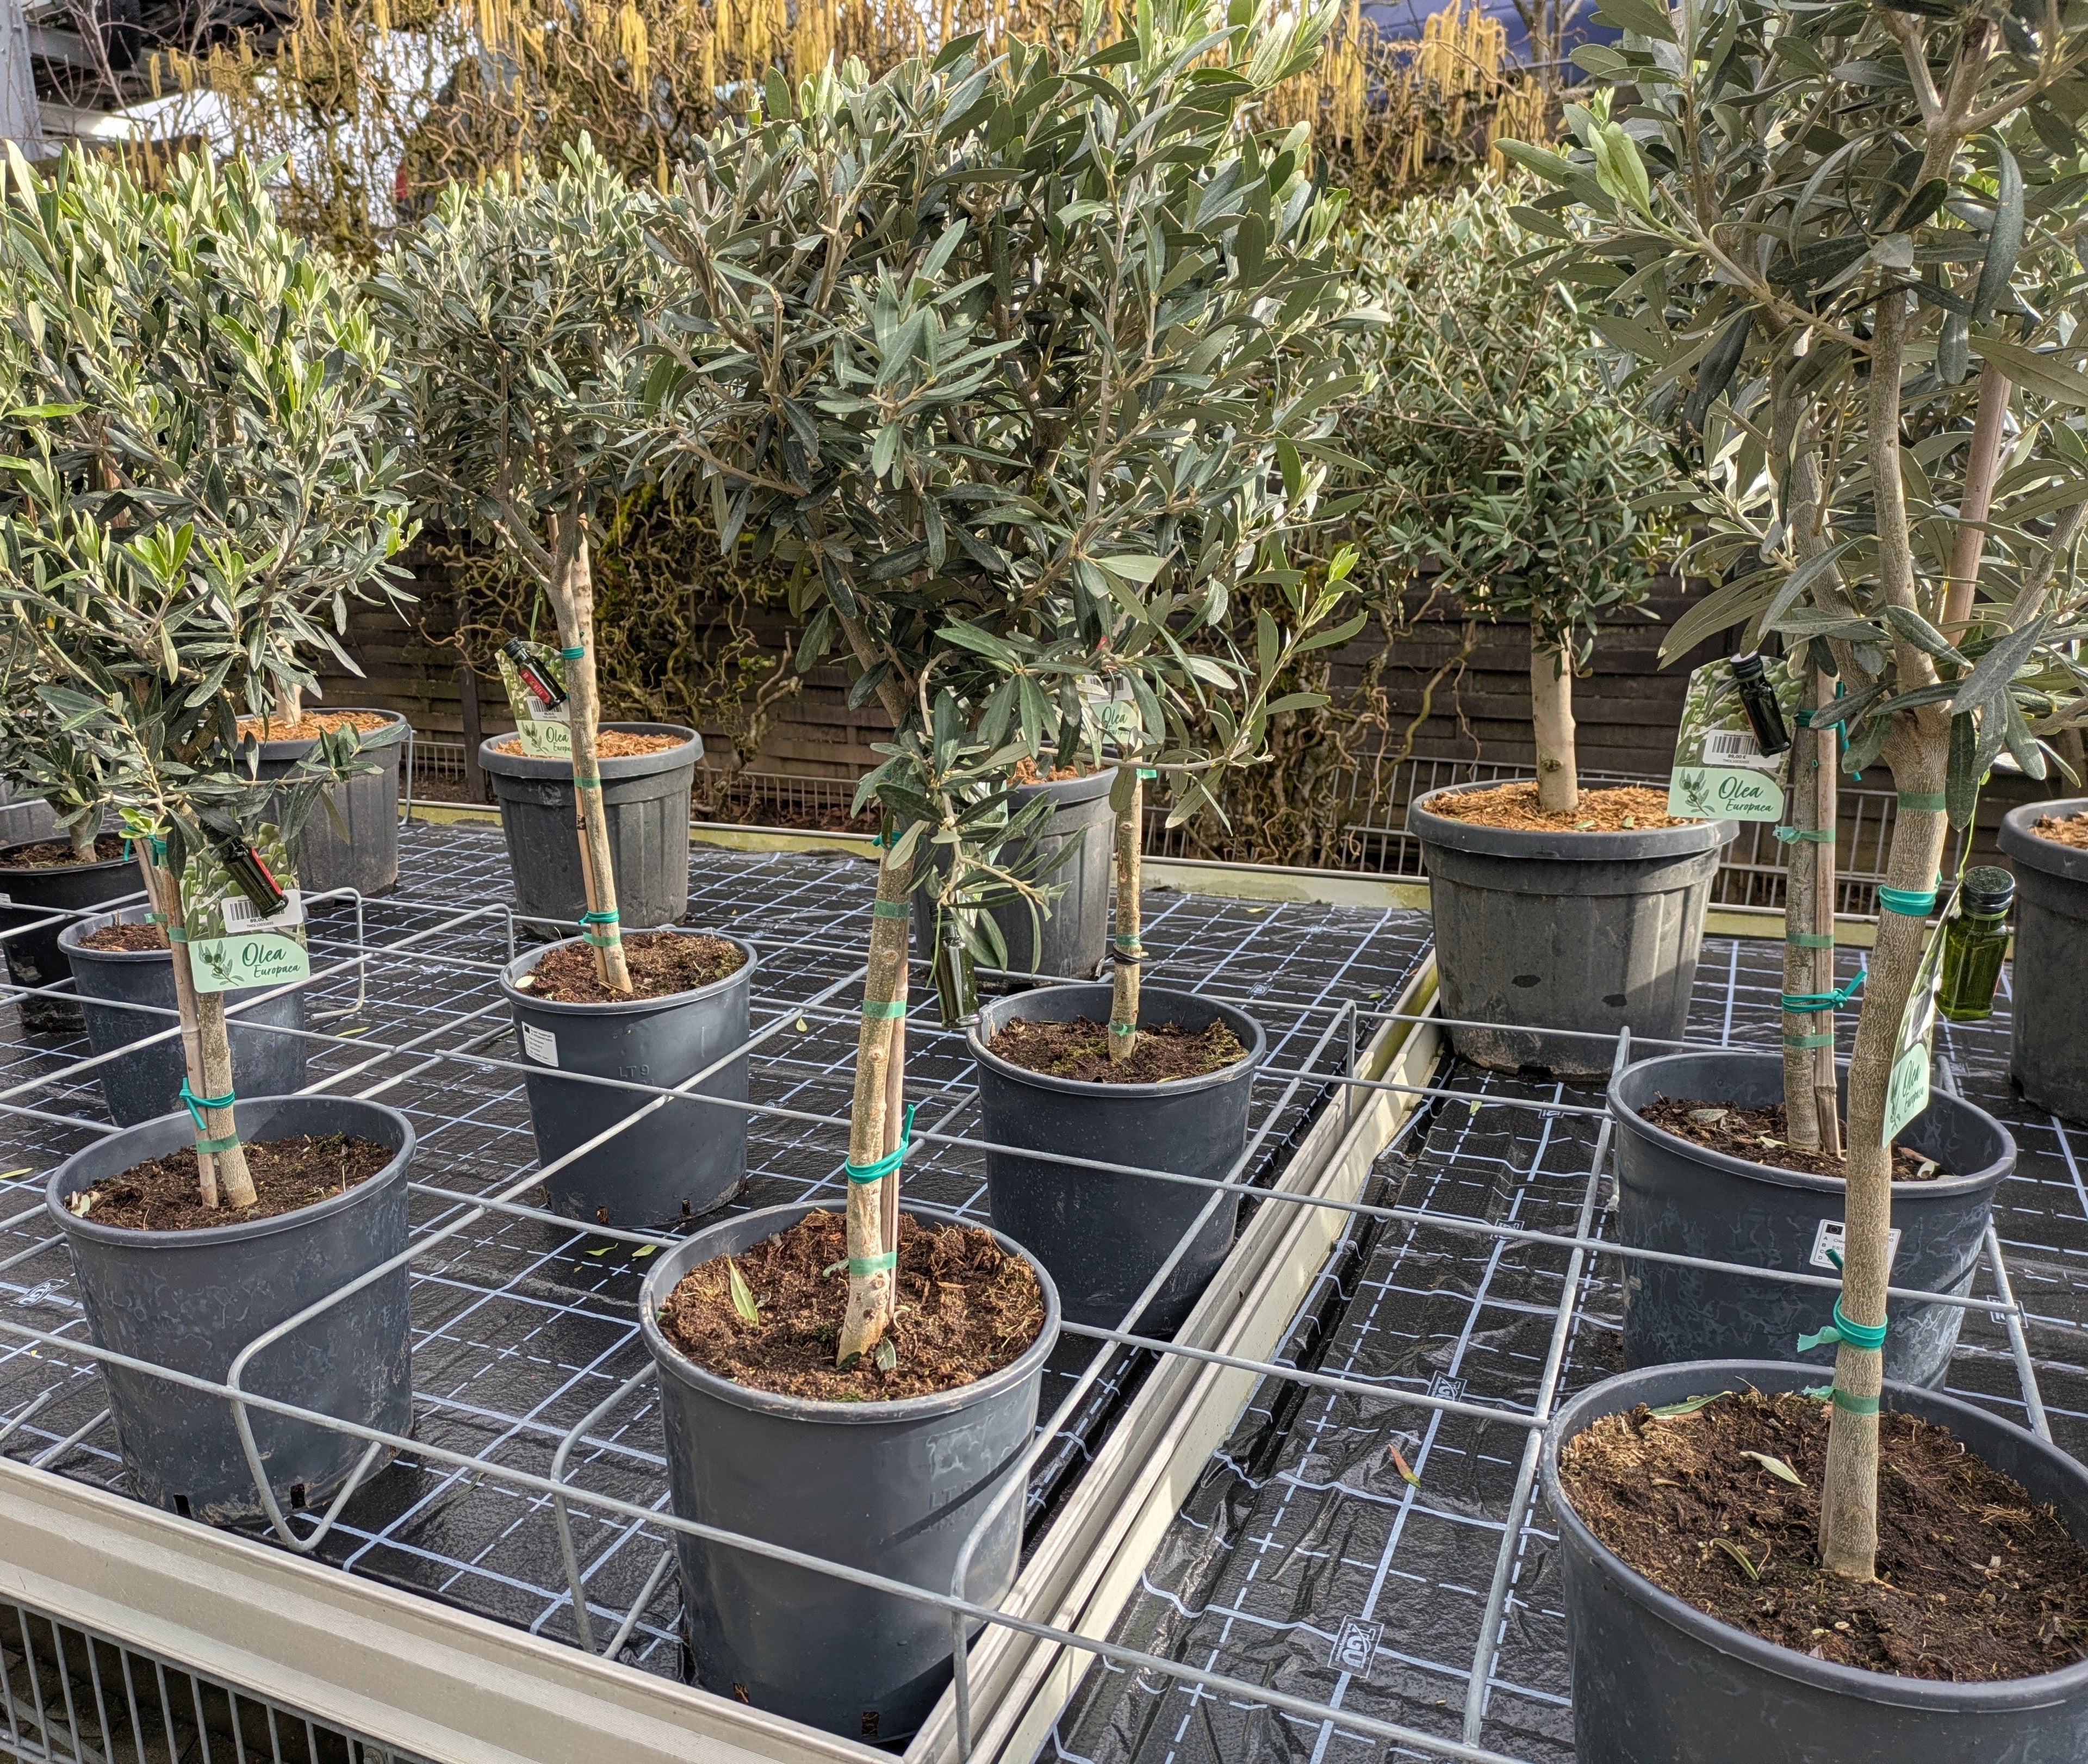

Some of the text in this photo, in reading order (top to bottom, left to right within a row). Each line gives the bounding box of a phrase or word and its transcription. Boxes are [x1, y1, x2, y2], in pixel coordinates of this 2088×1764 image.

[1102, 706, 1128, 728] Olea
[546, 726, 569, 743] Olea
[552, 742, 572, 754] Europa
[1718, 777, 1763, 799] Olea
[1725, 798, 1774, 814] Europaea
[242, 942, 287, 966] Olea
[253, 964, 300, 978] Europaea
